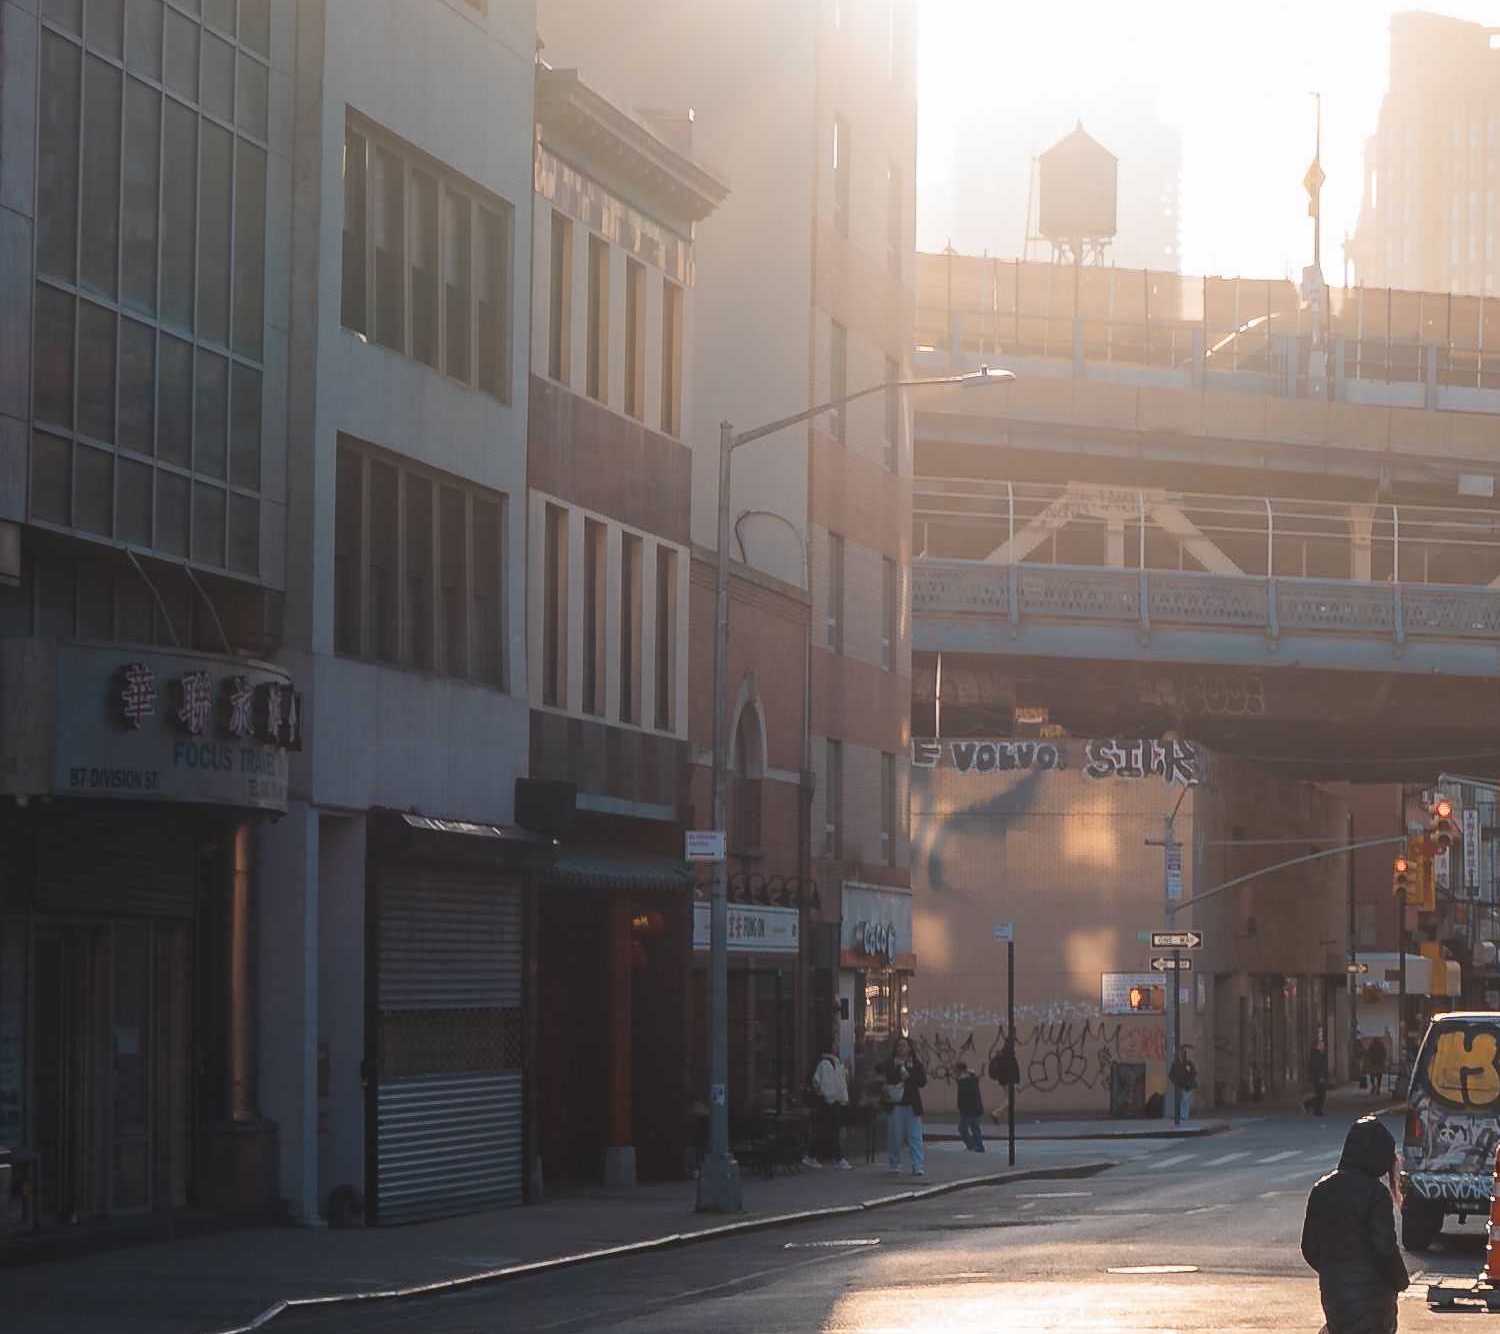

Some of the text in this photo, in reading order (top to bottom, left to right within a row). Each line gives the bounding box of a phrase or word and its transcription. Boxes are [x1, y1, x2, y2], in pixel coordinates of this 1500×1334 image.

[173, 741, 276, 777] FOCUS TRAVEL
[70, 768, 160, 791] 87 DIVISION ST.
